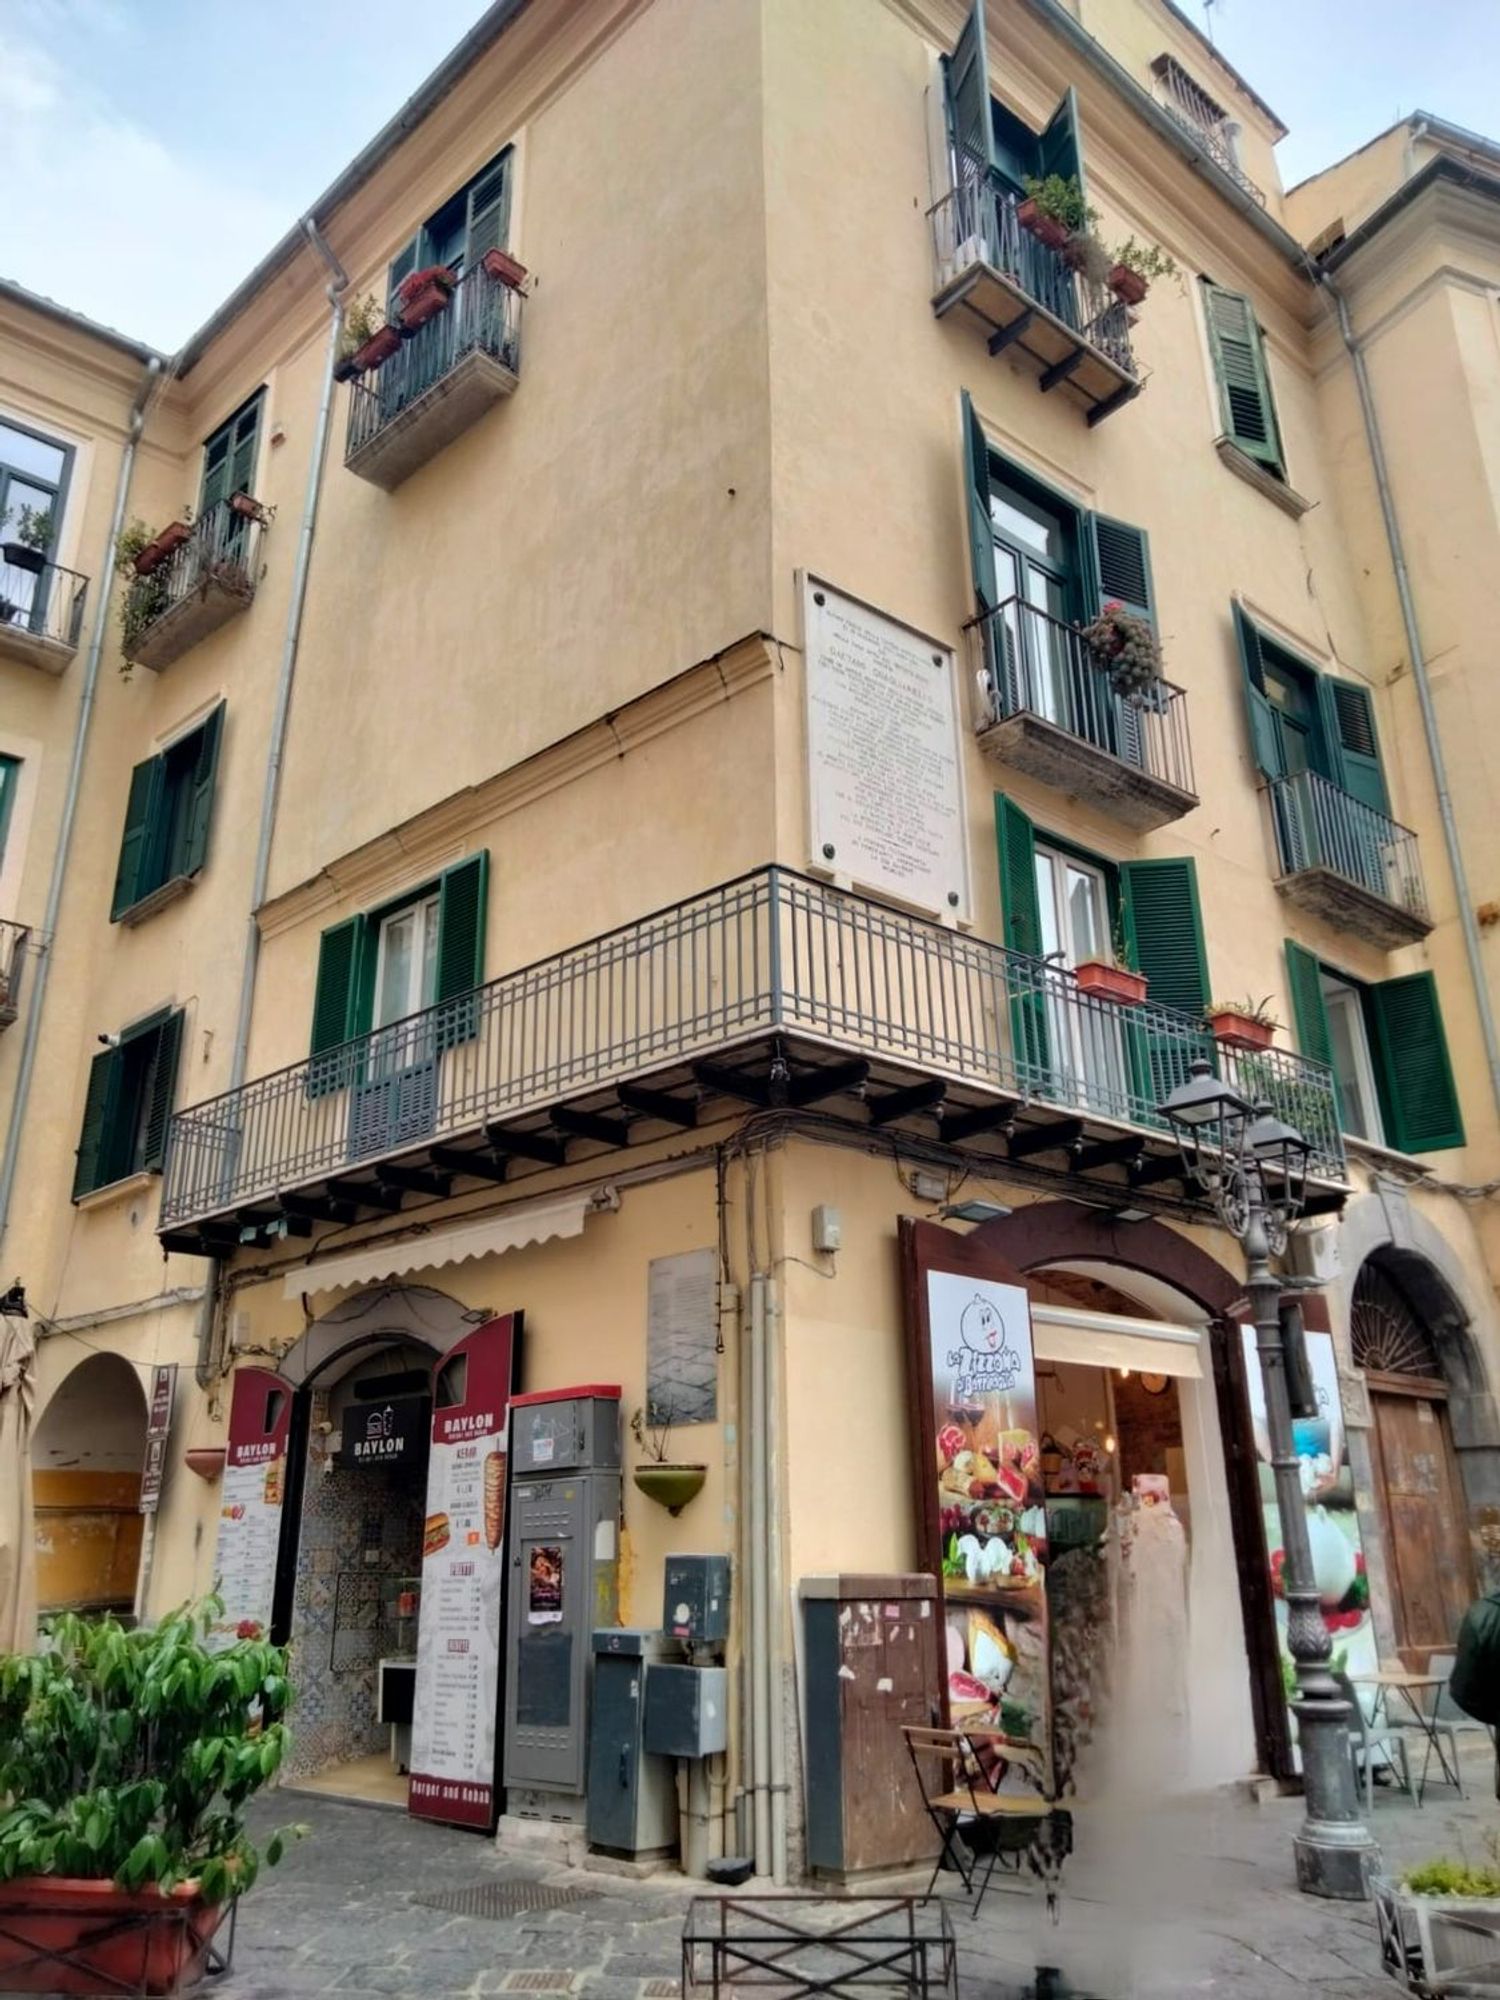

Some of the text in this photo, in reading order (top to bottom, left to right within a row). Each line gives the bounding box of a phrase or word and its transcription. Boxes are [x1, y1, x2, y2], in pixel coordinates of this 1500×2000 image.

[444, 1413, 494, 1434] BAYLON
[236, 1442, 277, 1458] BAYLON
[354, 1437, 405, 1456] BAYLON
